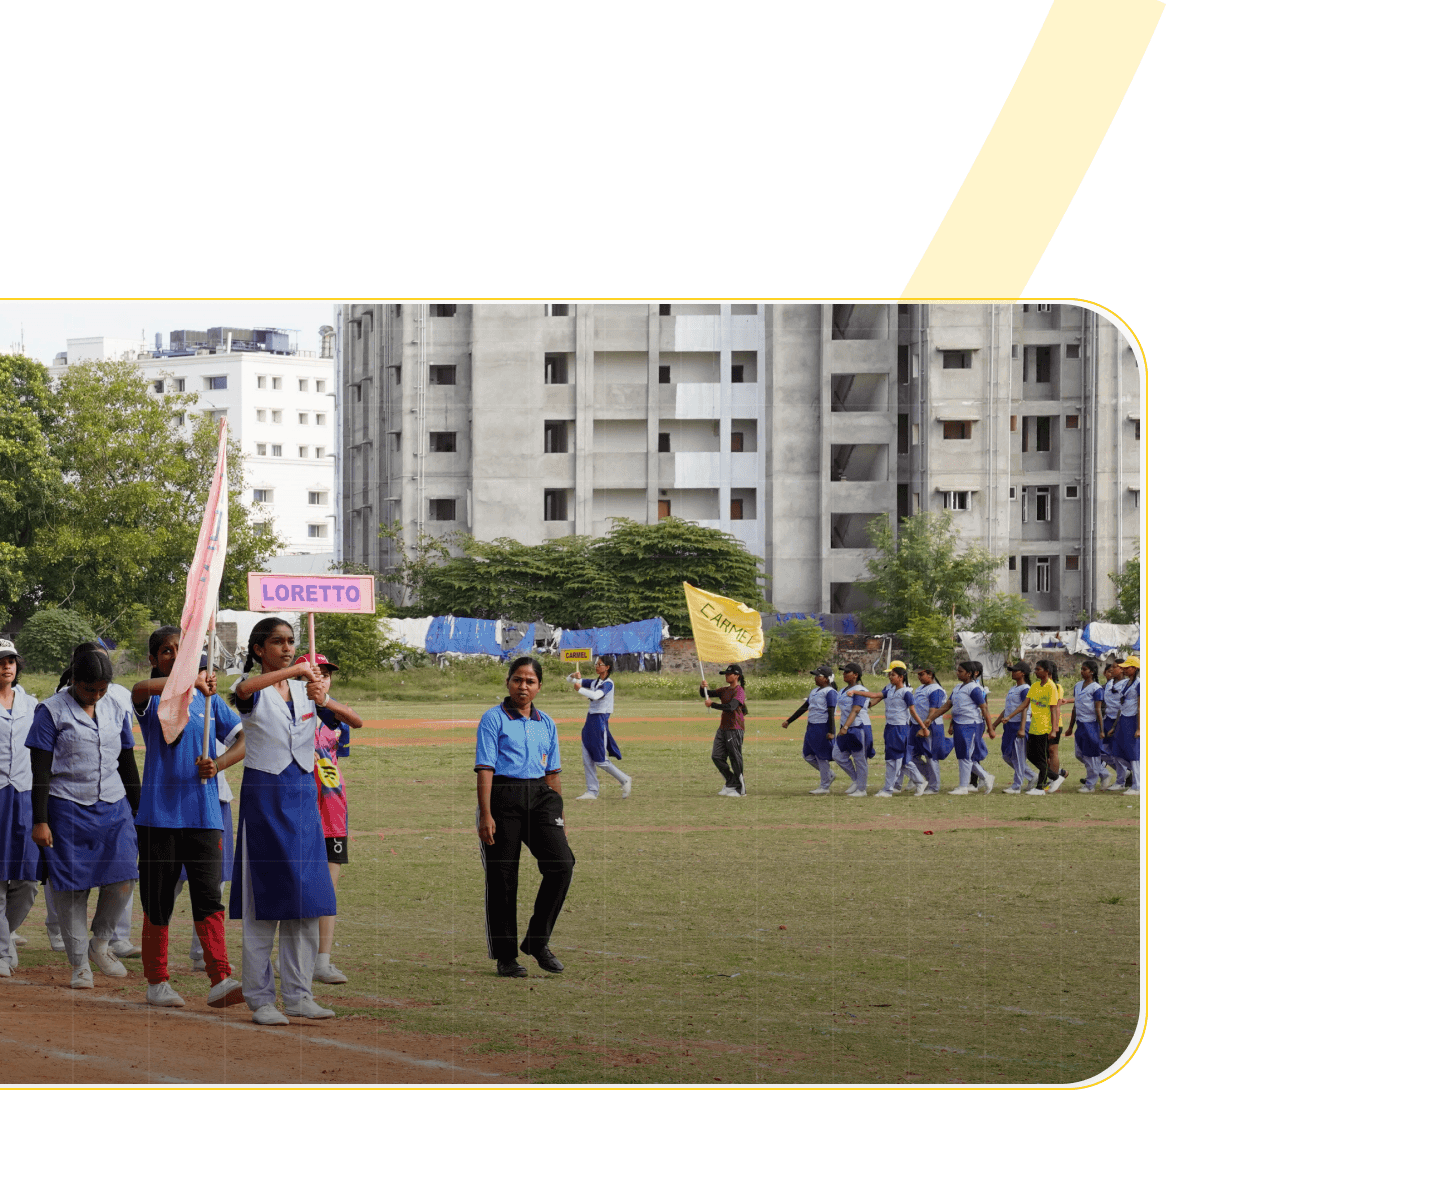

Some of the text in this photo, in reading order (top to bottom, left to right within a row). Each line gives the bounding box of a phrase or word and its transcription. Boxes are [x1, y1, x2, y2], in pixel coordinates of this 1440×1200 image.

[262, 584, 360, 602] LORETTO
[700, 602, 754, 649] CARMEL
[565, 651, 588, 659] CARMEL
